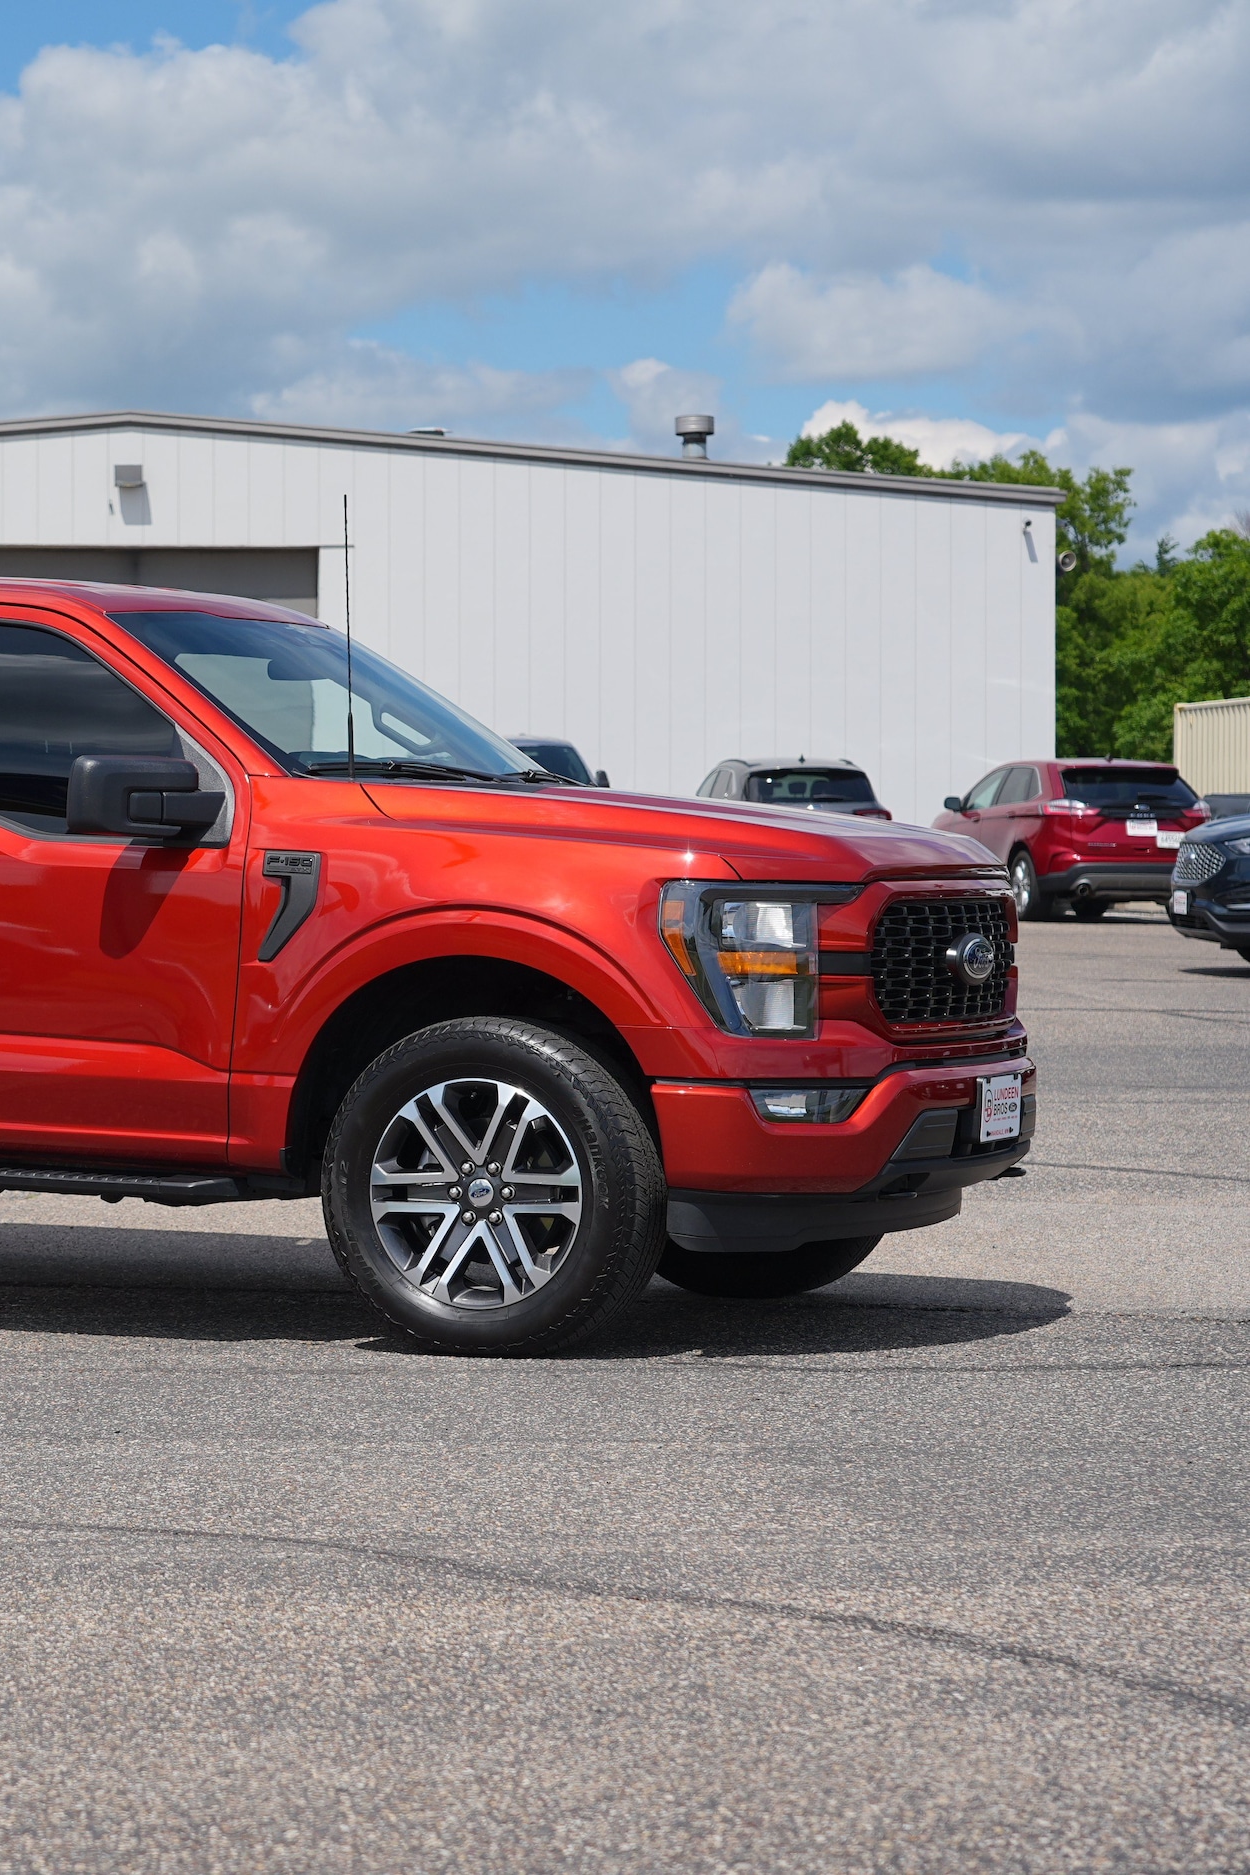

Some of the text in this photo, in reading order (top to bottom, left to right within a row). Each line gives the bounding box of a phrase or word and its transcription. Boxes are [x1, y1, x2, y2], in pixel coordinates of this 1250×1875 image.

[266, 855, 313, 867] F-150
[993, 1086, 1019, 1101] LUNDEEN
[993, 1102, 1008, 1116] BROS
